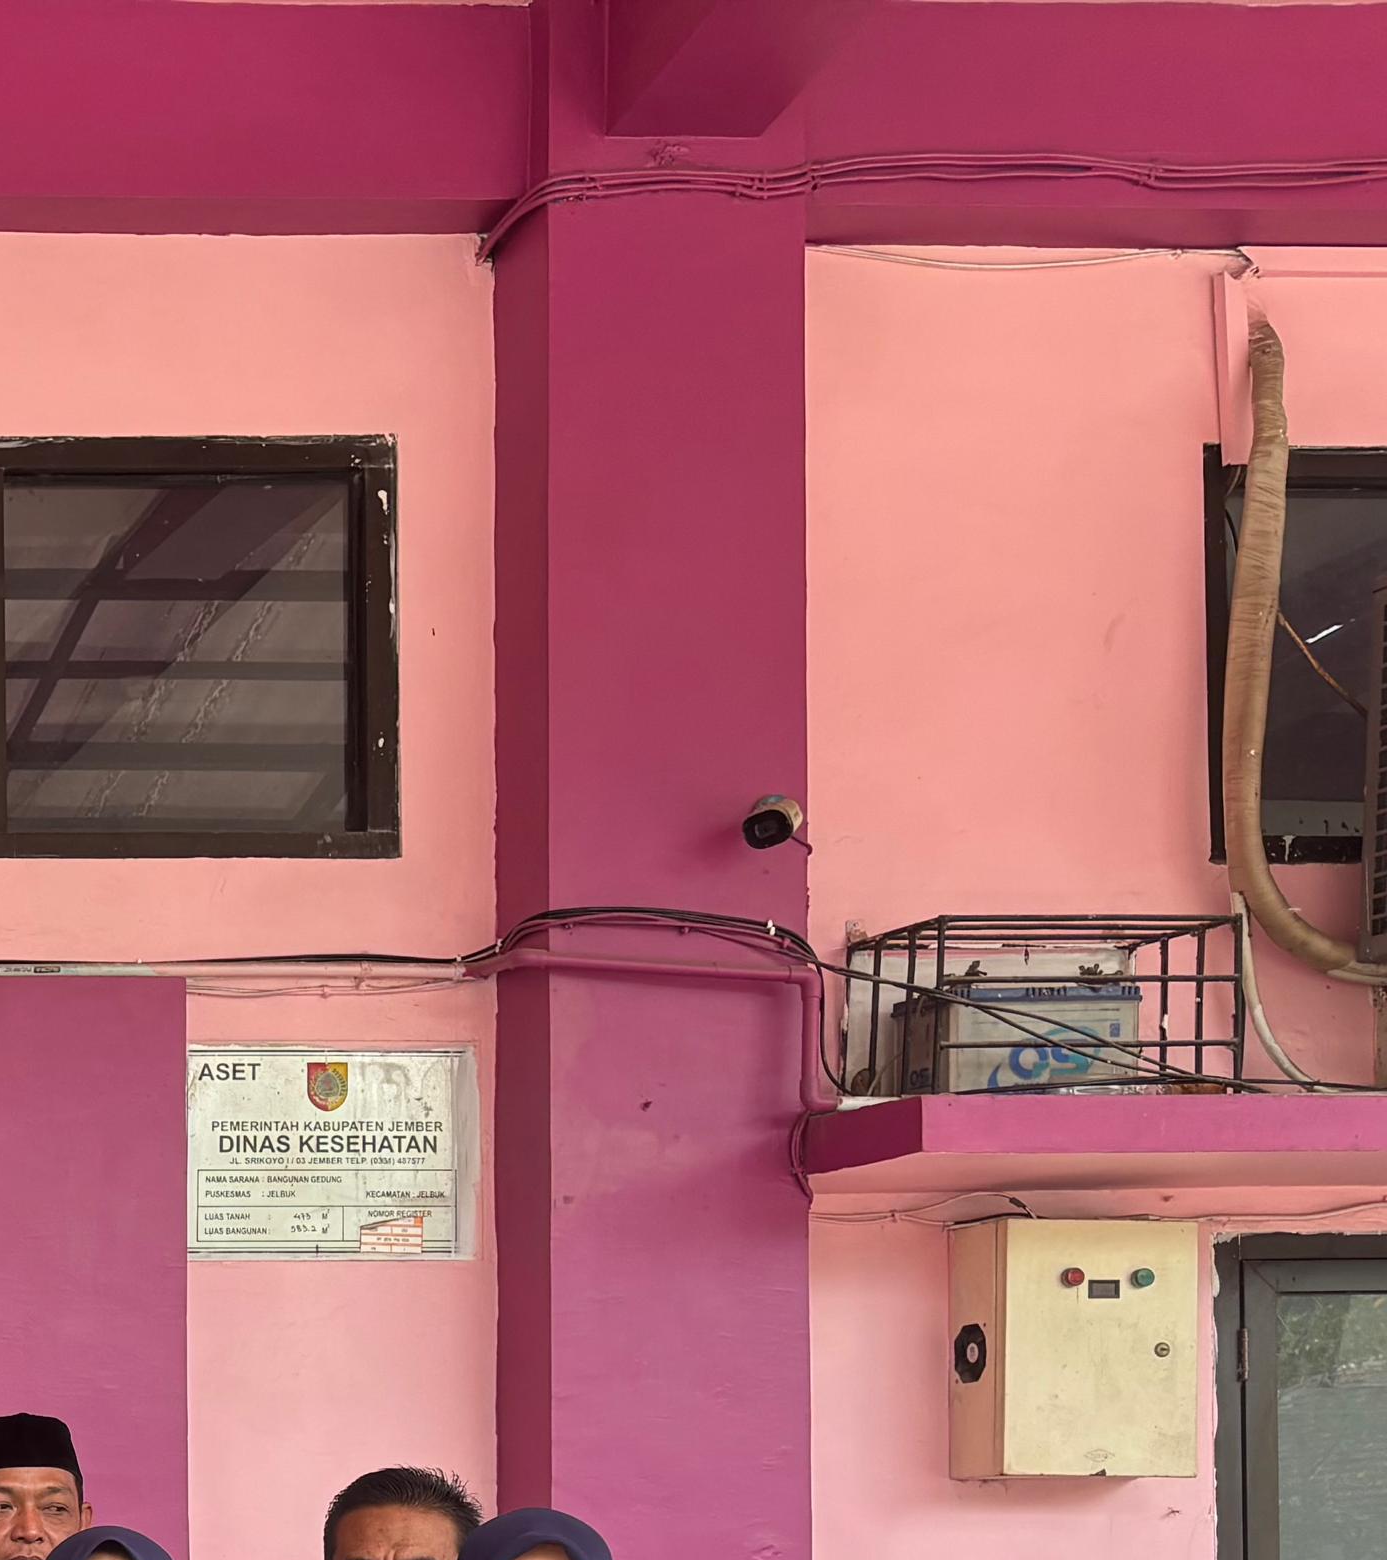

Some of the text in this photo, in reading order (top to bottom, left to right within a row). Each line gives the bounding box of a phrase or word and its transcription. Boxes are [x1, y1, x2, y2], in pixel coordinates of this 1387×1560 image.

[198, 1063, 261, 1081] ASET
[211, 1121, 443, 1132] PEMERINTAH KABUPATEN JEMBER
[219, 1135, 437, 1153] DINAS KESEHATAN
[244, 1157, 285, 1165] SRIKOYO
[308, 1157, 343, 1165] JEMBER
[205, 1190, 251, 1198] PUSKESMAS
[267, 1190, 296, 1198] JELBUK
[366, 1191, 411, 1199] KECAMATAN
[416, 1191, 445, 1199] JELBUK
[204, 1213, 224, 1221] LUAS
[226, 1213, 251, 1221] TANAH
[368, 1210, 432, 1218] NOMOR REGISTER
[204, 1227, 224, 1235] LUAS
